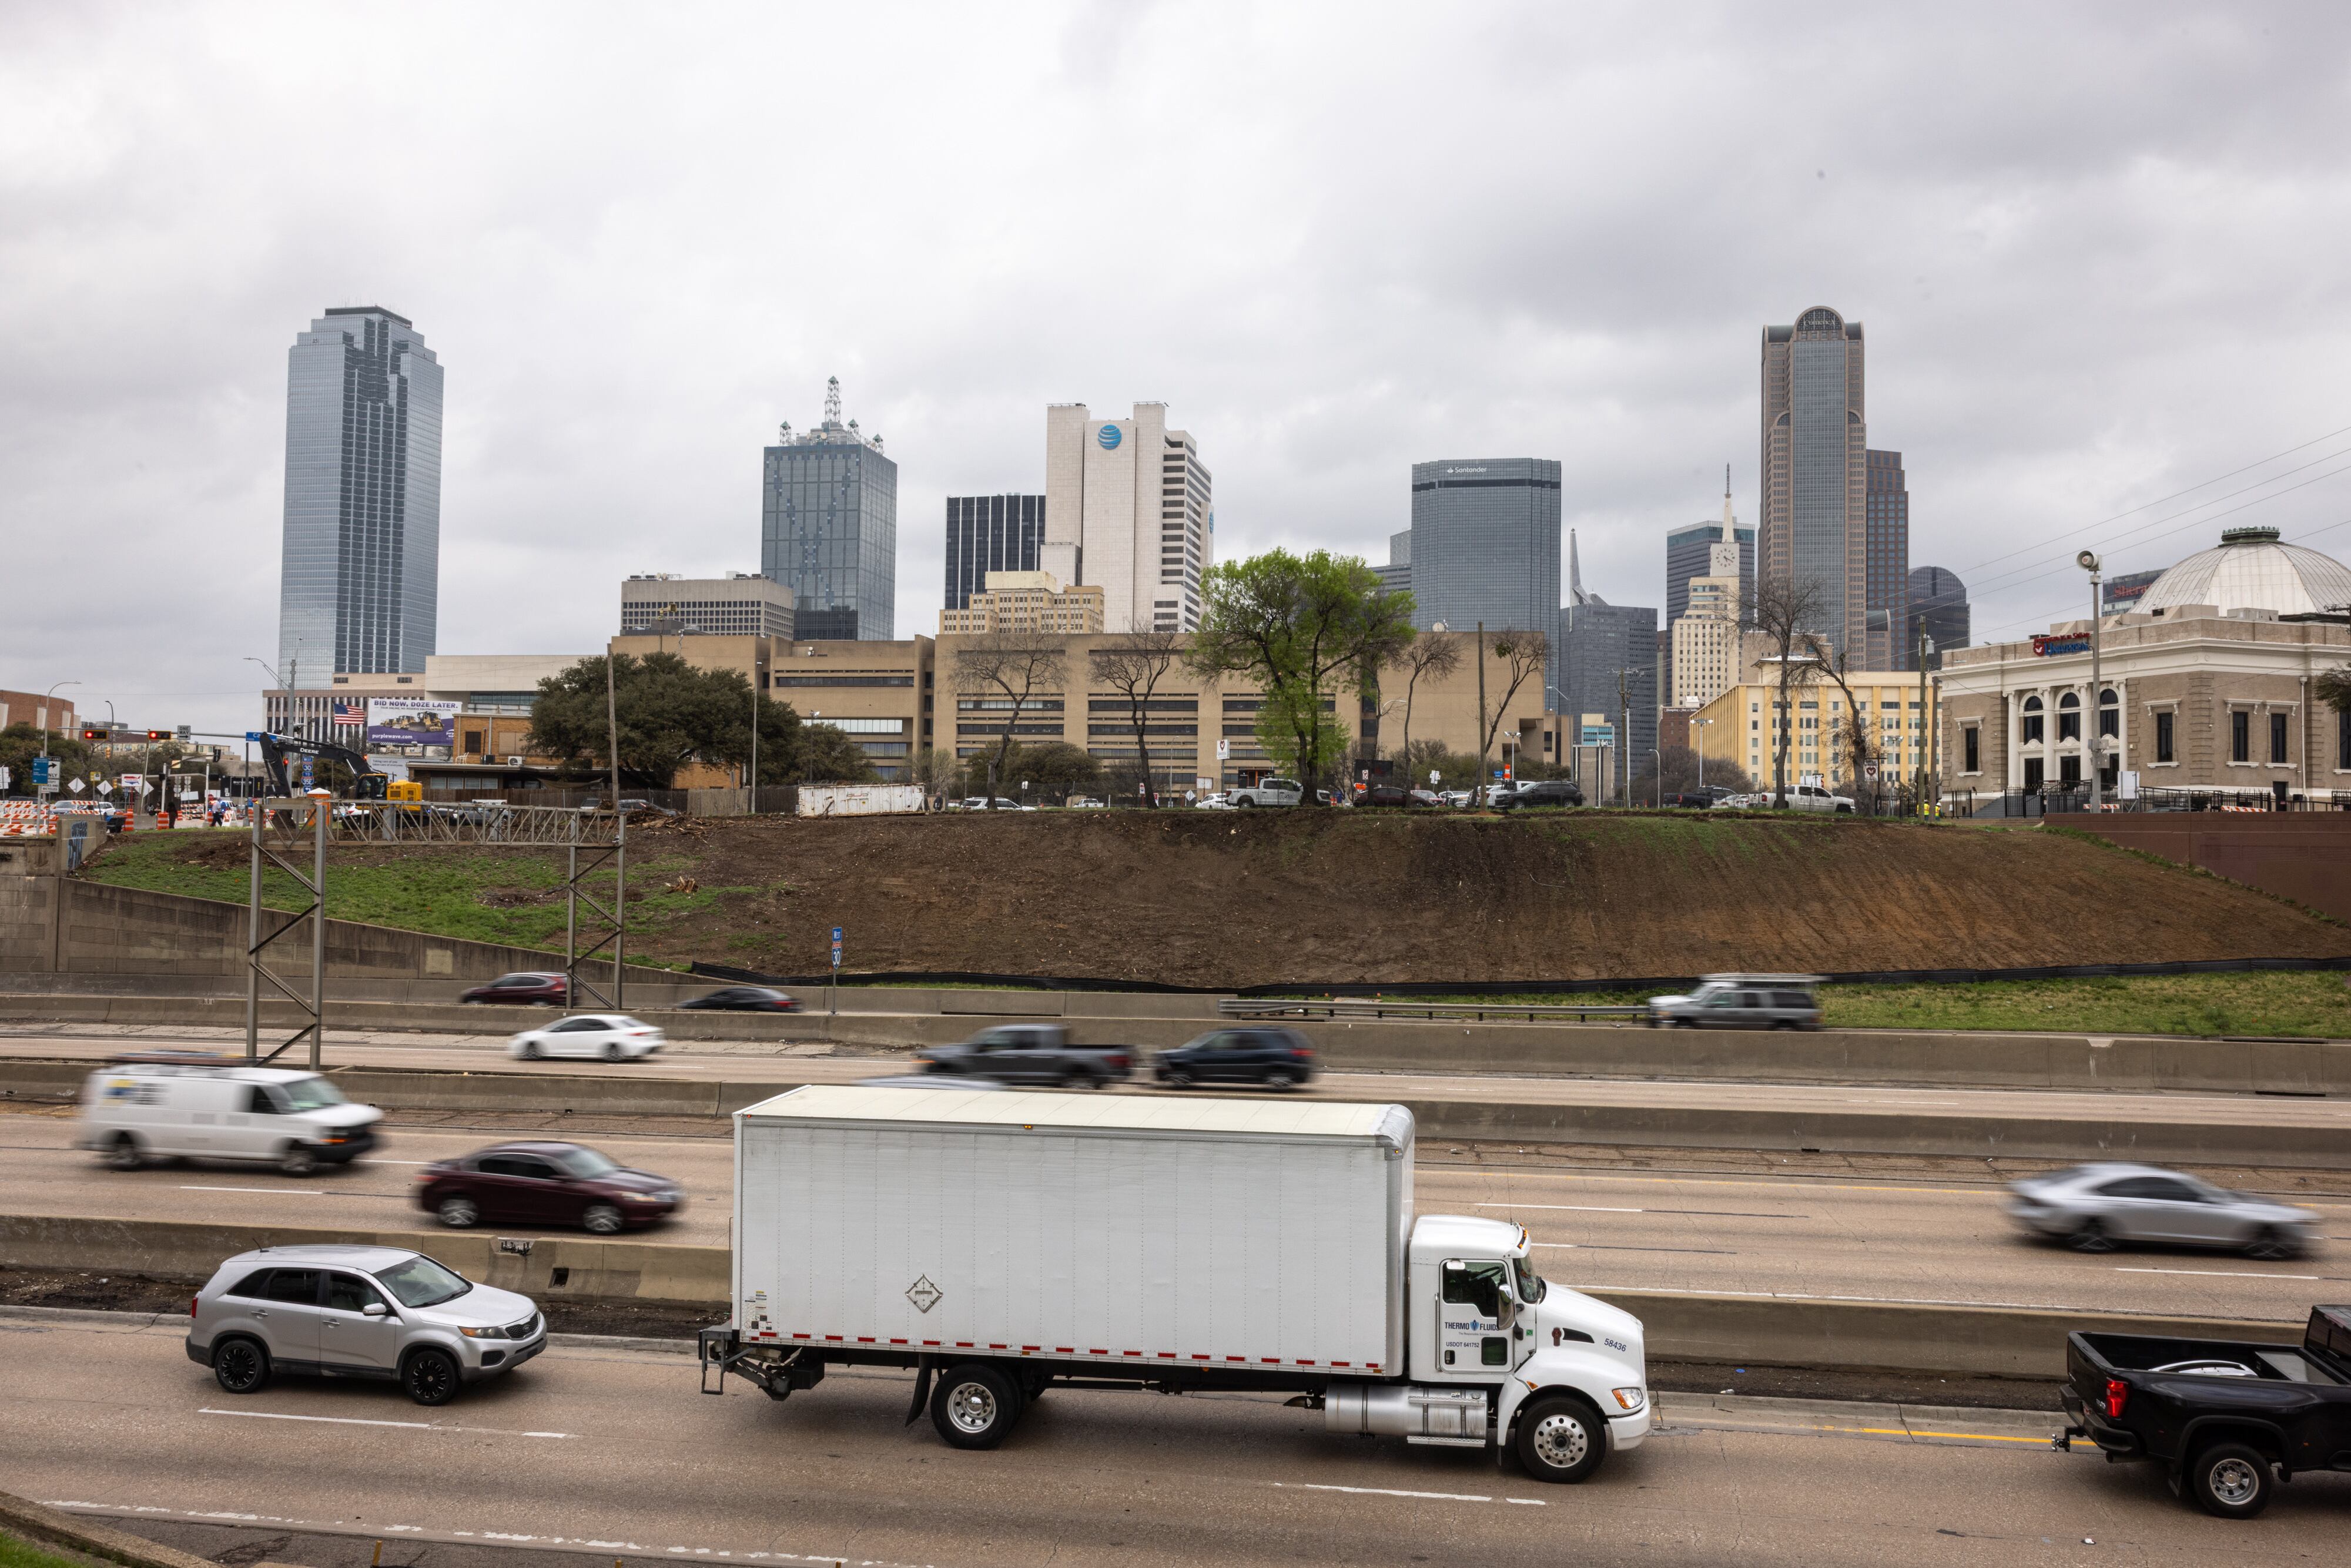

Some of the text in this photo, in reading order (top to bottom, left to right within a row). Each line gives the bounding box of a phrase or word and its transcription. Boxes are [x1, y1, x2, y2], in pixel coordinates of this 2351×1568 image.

[2115, 583, 2152, 598] Shera
[833, 950, 840, 964] 30
[1604, 1338, 1627, 1352] 58436
